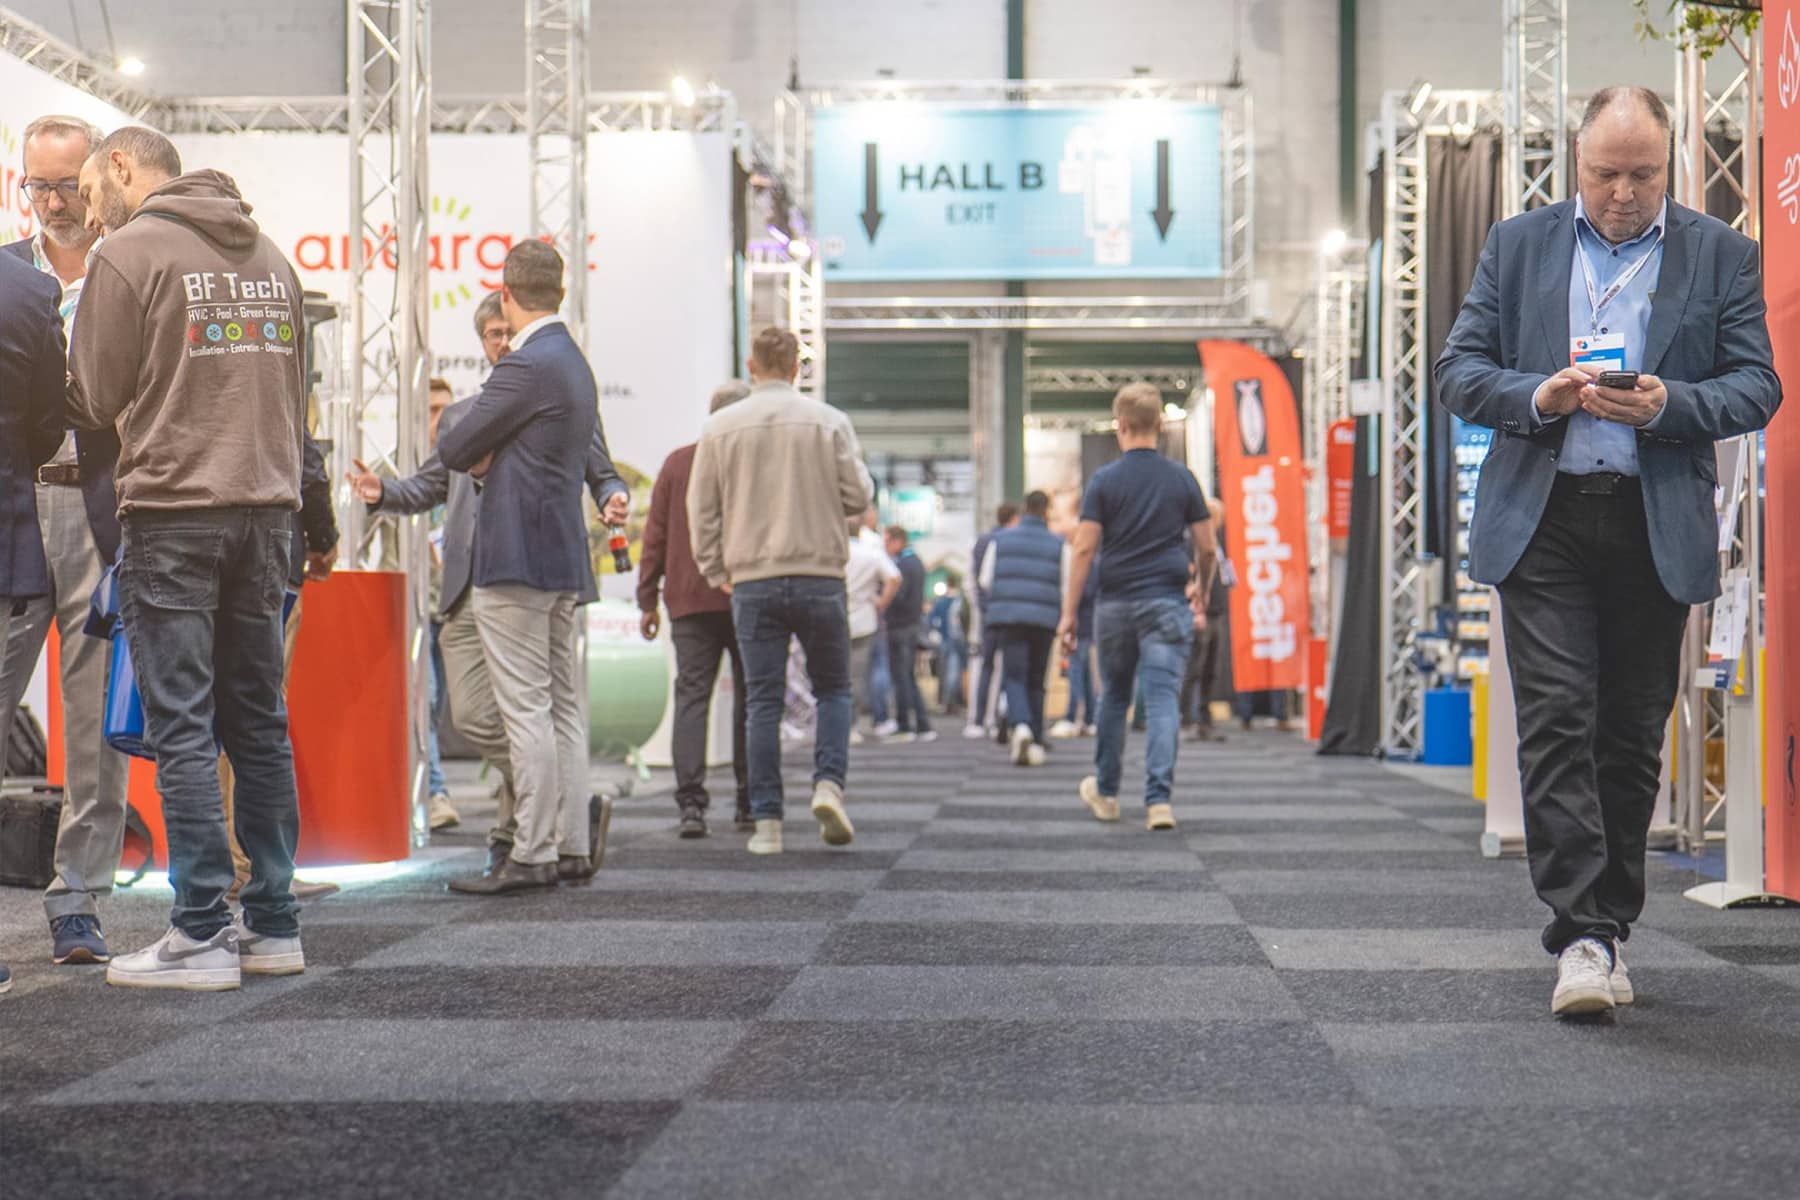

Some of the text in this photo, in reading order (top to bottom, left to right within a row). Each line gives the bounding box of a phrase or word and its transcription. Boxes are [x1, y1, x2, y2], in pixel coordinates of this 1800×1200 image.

[900, 161, 1044, 190] HALL B
[946, 203, 995, 223] EXIT
[295, 222, 597, 290] antrg
[182, 272, 287, 301] BF Tech
[240, 306, 264, 318] Green
